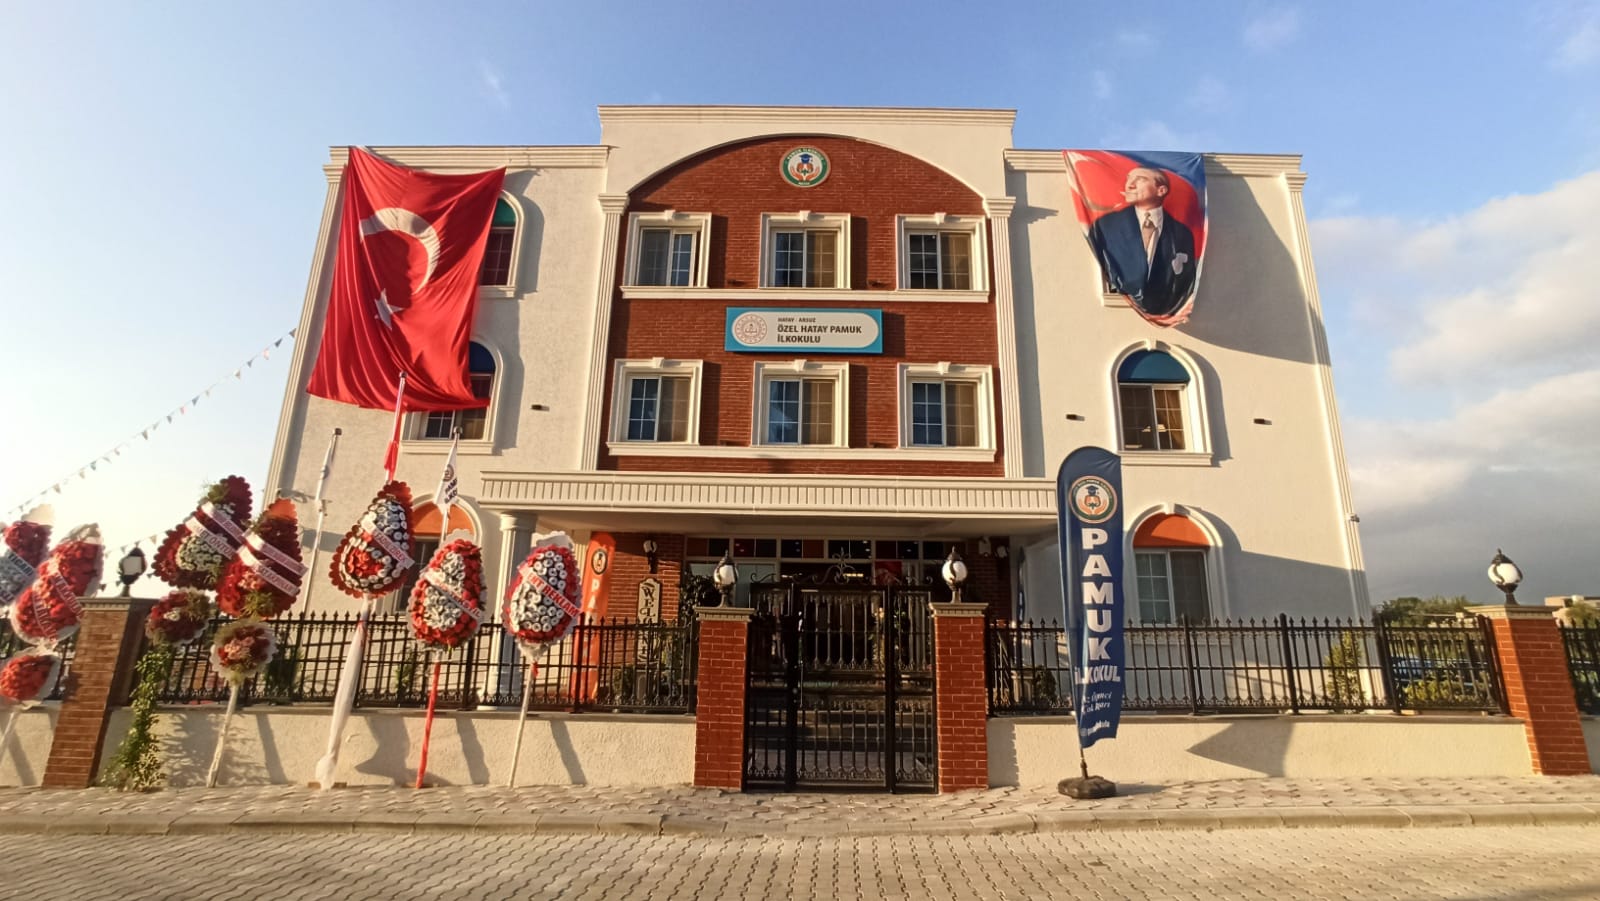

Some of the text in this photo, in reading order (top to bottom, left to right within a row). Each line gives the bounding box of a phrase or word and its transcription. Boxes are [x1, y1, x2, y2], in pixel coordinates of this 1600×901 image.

[776, 333, 821, 343] İLKOKULU
[777, 323, 862, 334] ÖZEL HATAY PAMUK
[541, 585, 579, 616] REKLAM
[1080, 528, 1114, 661] PAMUK
